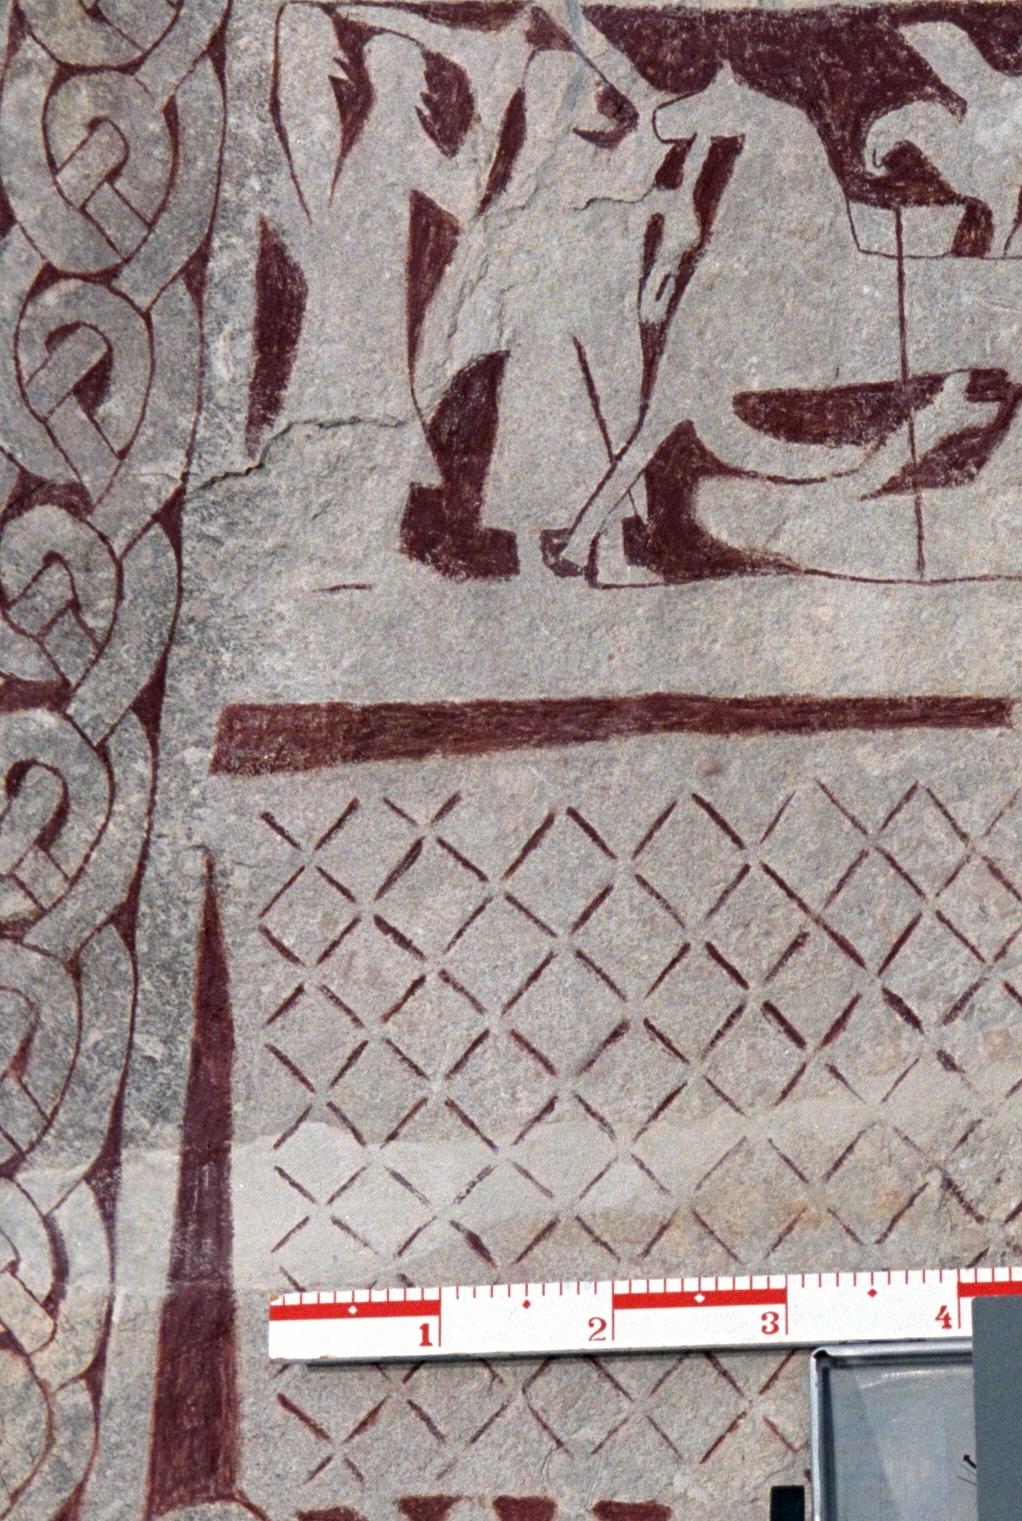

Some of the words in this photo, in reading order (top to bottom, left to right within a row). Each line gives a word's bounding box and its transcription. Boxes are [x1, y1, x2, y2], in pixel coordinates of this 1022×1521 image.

[418, 1323, 432, 1347] 1
[588, 1317, 607, 1341] 2
[760, 1311, 780, 1334] 3
[934, 1305, 952, 1329] 4
